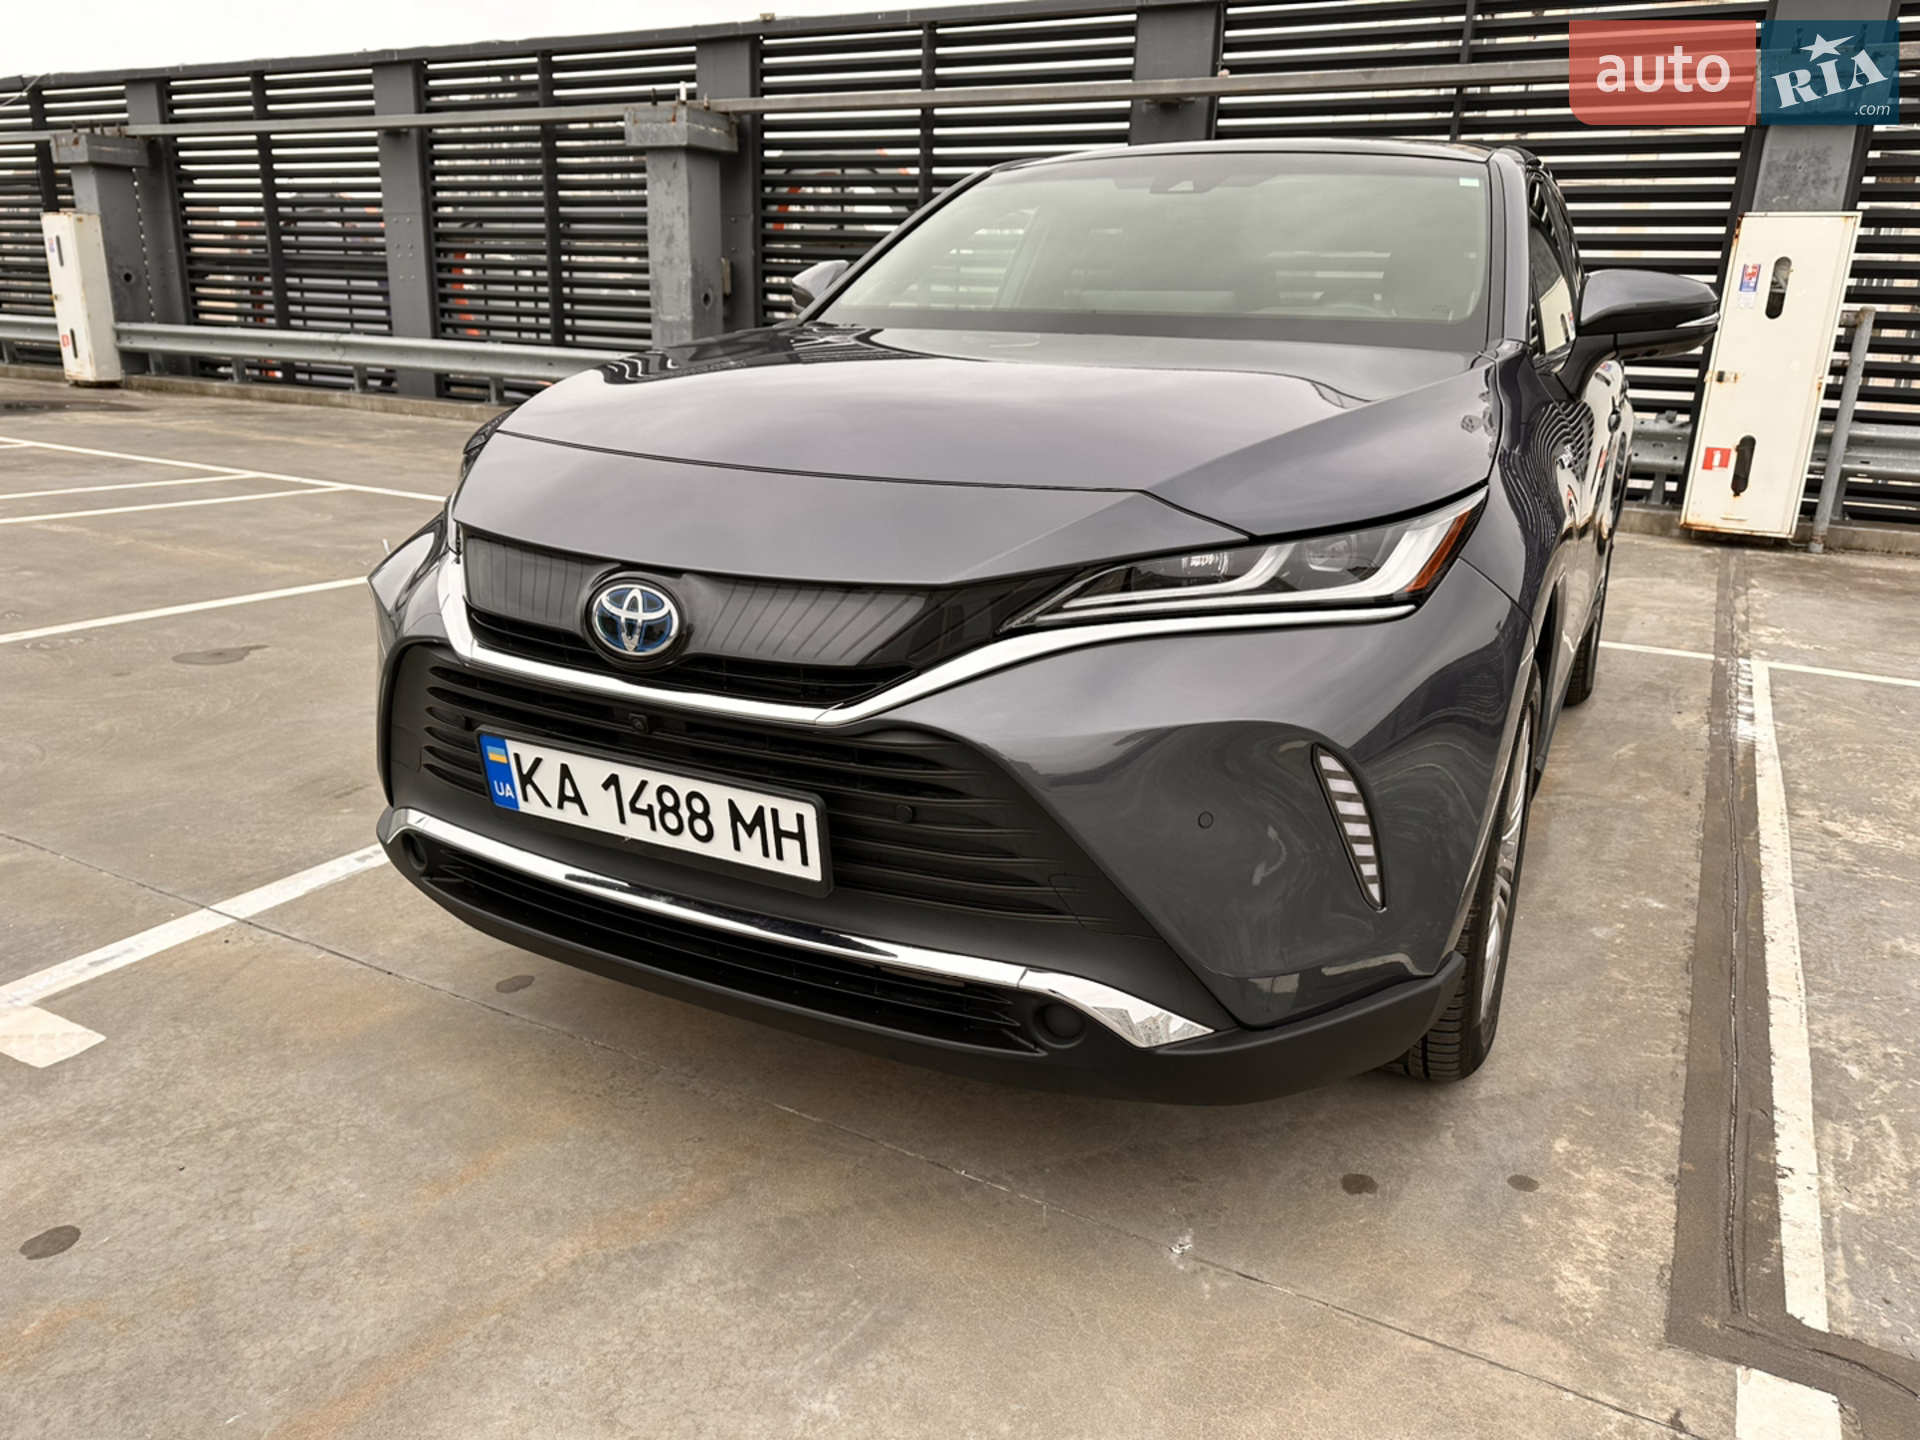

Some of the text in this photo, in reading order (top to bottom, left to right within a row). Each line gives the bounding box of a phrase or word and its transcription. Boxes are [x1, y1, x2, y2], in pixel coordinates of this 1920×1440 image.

[493, 780, 515, 799] UA
[513, 752, 809, 867] KA 1488 MH
